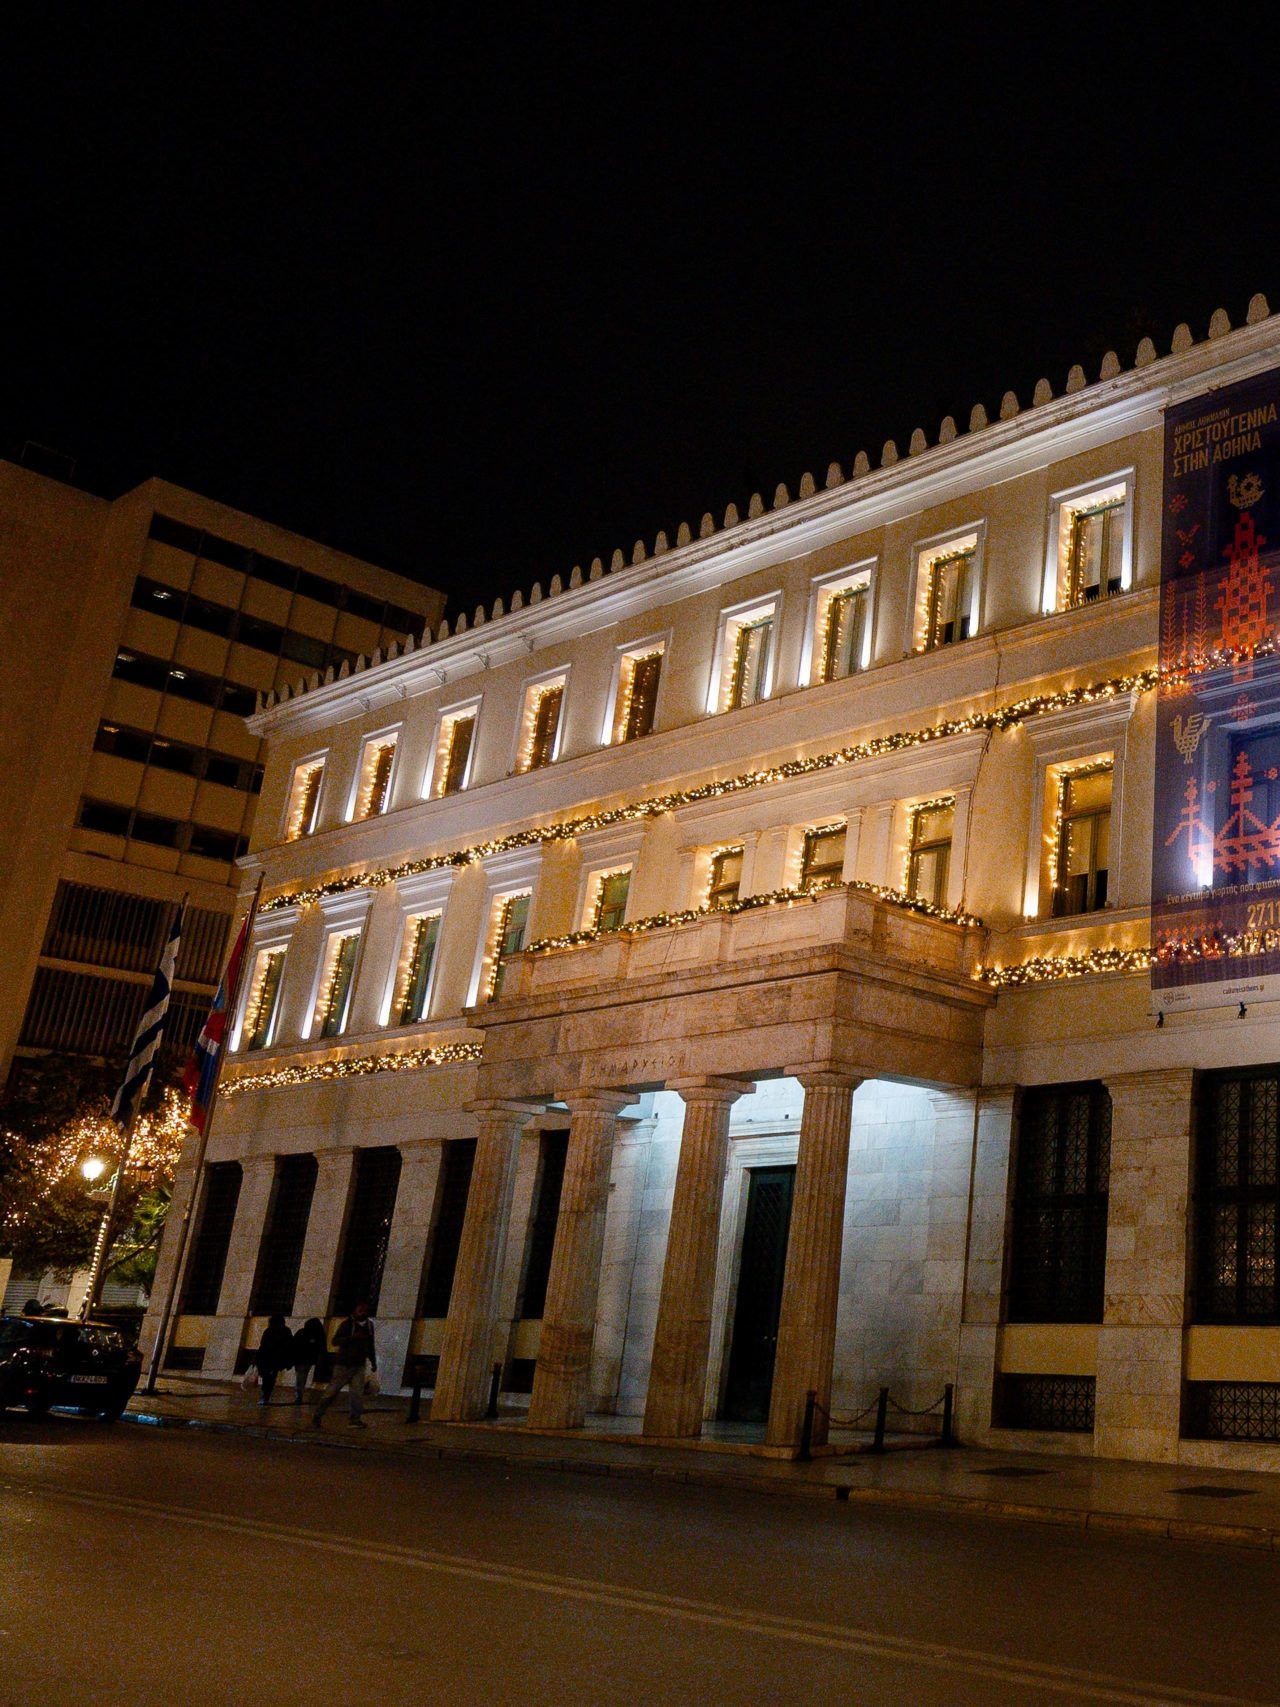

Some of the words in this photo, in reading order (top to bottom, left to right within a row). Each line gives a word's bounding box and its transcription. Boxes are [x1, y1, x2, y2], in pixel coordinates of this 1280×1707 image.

[1173, 402, 1278, 456] ΧΡΙΣΤΟΥΓΕΝΝΑ
[1173, 447, 1209, 478] ΣΤΗΝ
[1212, 431, 1262, 464] ΑΘΗΝΑ
[1241, 883, 1254, 892] που
